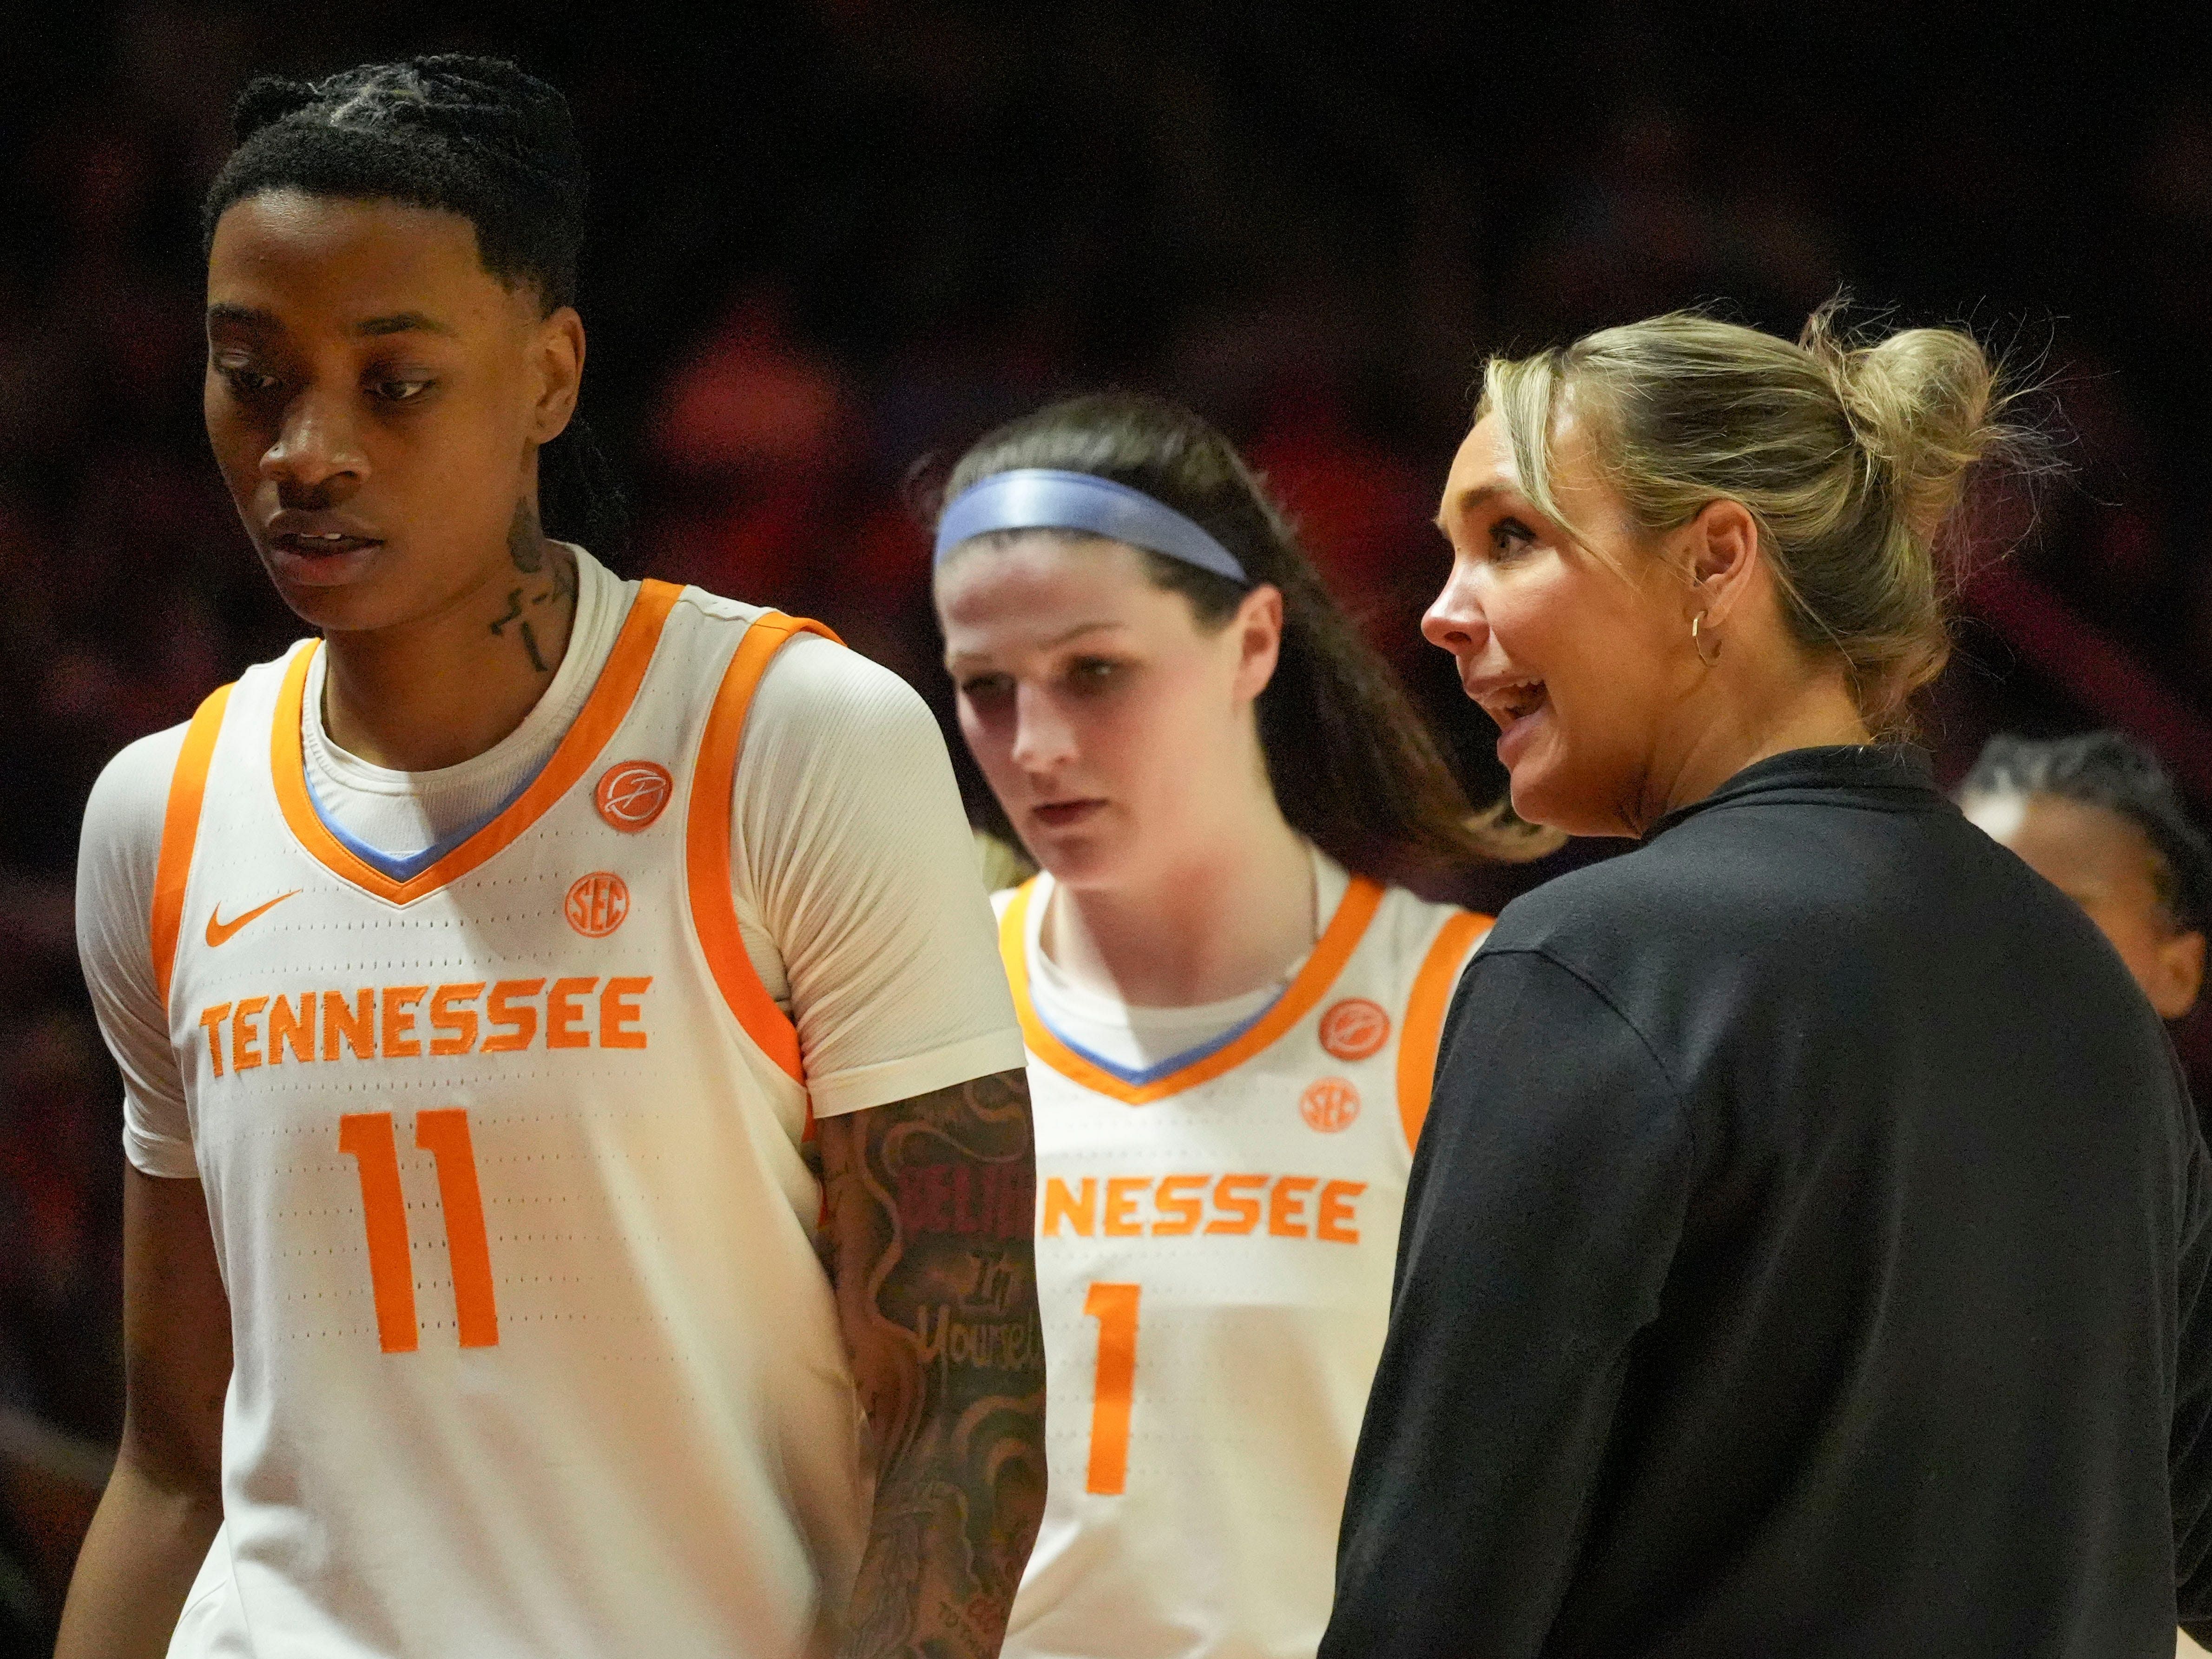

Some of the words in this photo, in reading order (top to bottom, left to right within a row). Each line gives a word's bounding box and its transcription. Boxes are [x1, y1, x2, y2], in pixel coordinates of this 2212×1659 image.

[570, 876, 625, 932] SEC
[200, 975, 653, 1077] TENNESSEE
[338, 1108, 500, 1354] 11
[1043, 1174, 1368, 1245] NESSEE
[1083, 1281, 1141, 1495] 1
